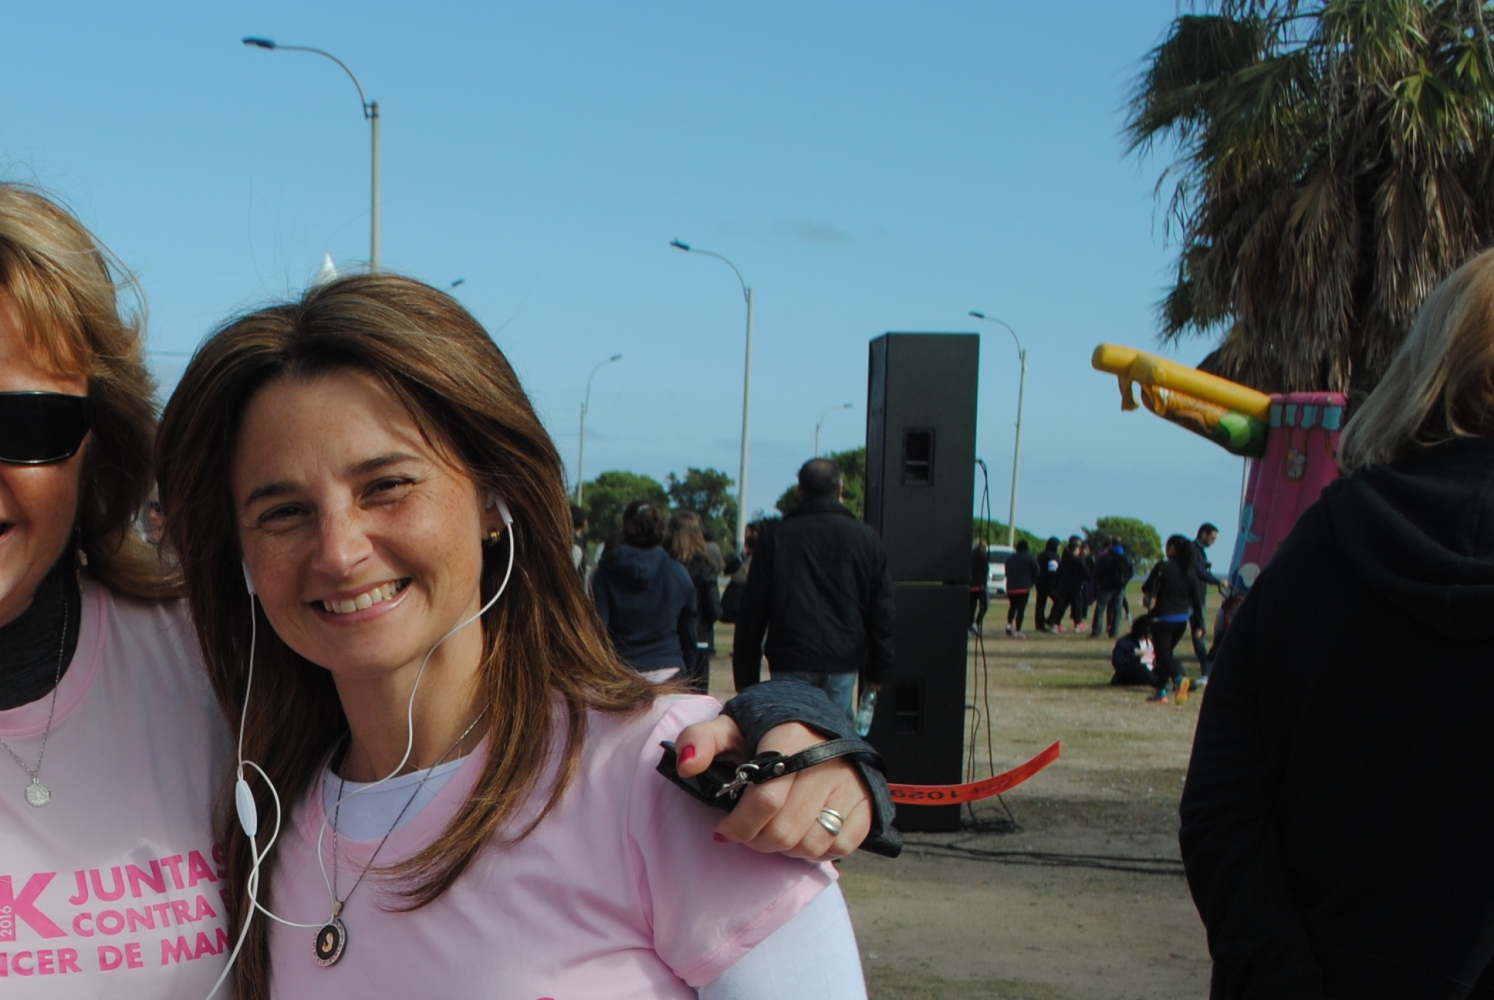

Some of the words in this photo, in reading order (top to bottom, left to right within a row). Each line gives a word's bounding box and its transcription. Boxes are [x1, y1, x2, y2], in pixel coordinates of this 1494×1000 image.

[0, 905, 12, 937] 2016
[72, 894, 217, 938] CONTRA
[98, 942, 144, 972] DE
